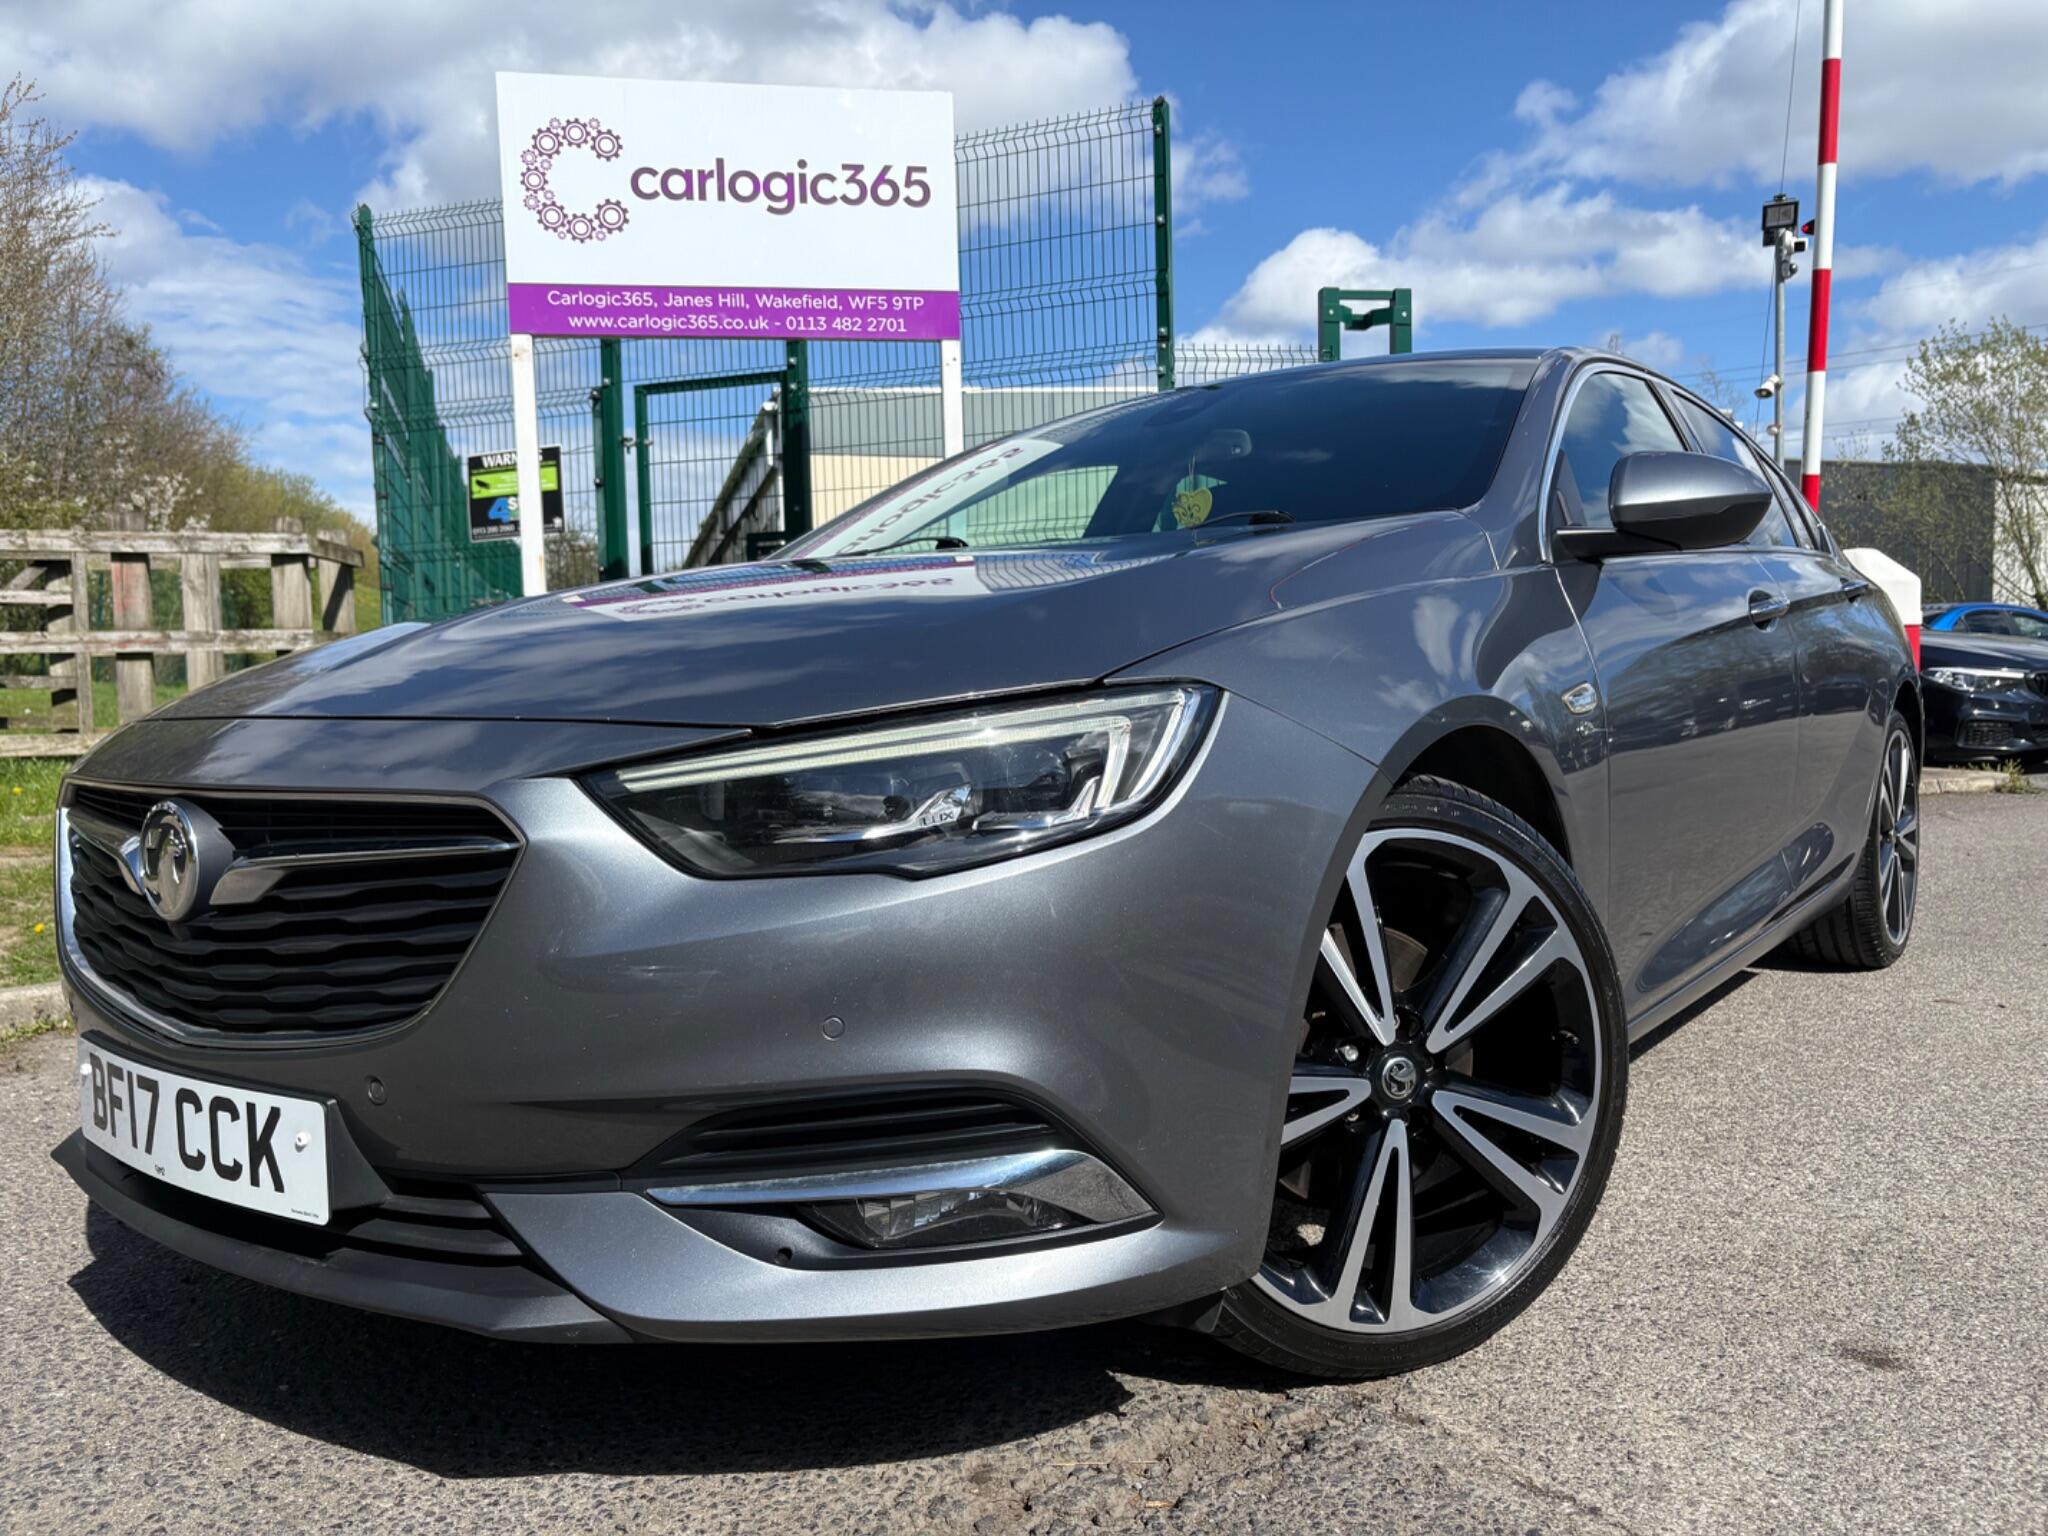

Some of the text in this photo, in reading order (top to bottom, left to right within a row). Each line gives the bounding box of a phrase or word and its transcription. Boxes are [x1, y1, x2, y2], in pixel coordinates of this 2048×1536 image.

[630, 157, 932, 216] carlogic365
[547, 290, 925, 311] Carlogic365, Janes Hill, Wakefield, WF5 9TP
[568, 314, 769, 331] www.carlogic365.co.uk
[785, 316, 827, 331] 0113
[832, 317, 862, 331] 482
[867, 317, 908, 332] 2701
[89, 1052, 285, 1194] BF17 CCK
